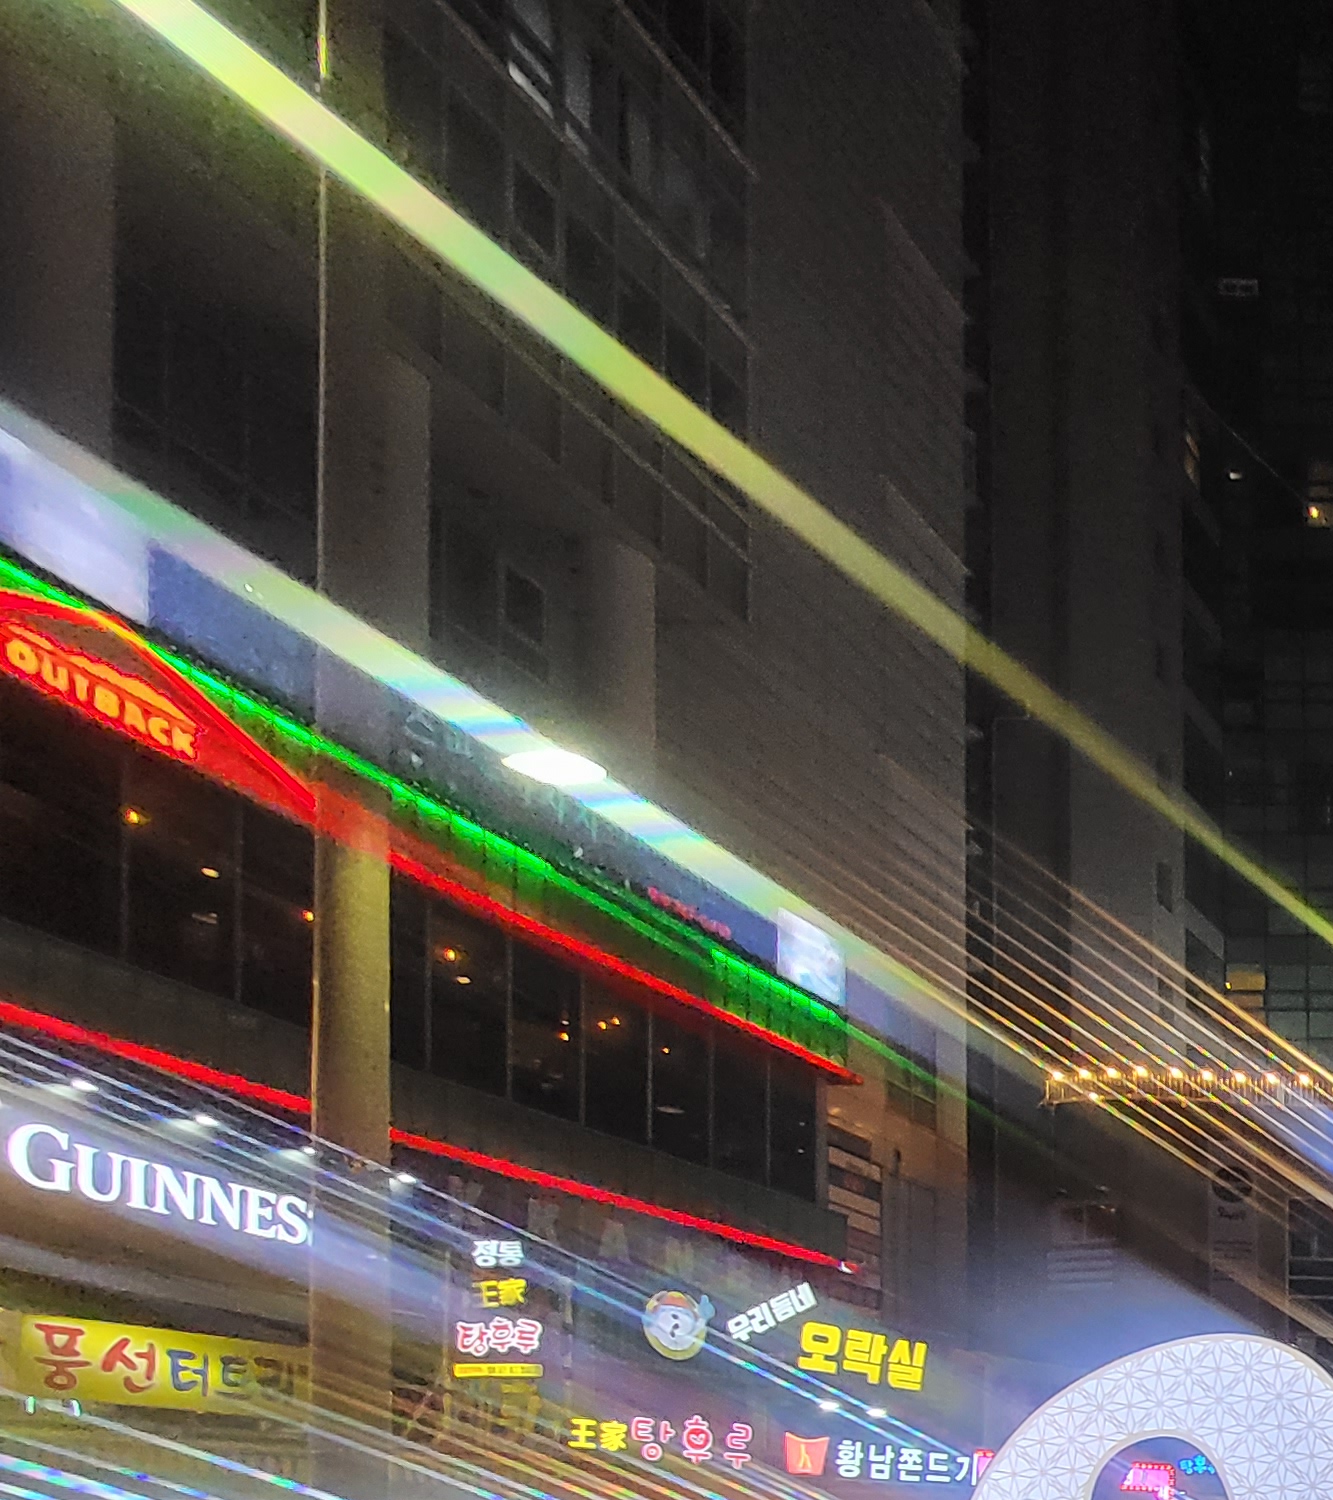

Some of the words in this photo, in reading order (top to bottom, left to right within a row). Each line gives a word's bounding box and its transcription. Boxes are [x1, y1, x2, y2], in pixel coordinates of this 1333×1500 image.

[6, 638, 196, 759] OUTBACK
[8, 1124, 313, 1246] GUINNES
[472, 1240, 524, 1267] 정통
[456, 1317, 543, 1357] 탕후루
[797, 1322, 928, 1391] 오락실
[569, 1418, 627, 1450] 王家
[630, 1416, 752, 1469] 탕후루
